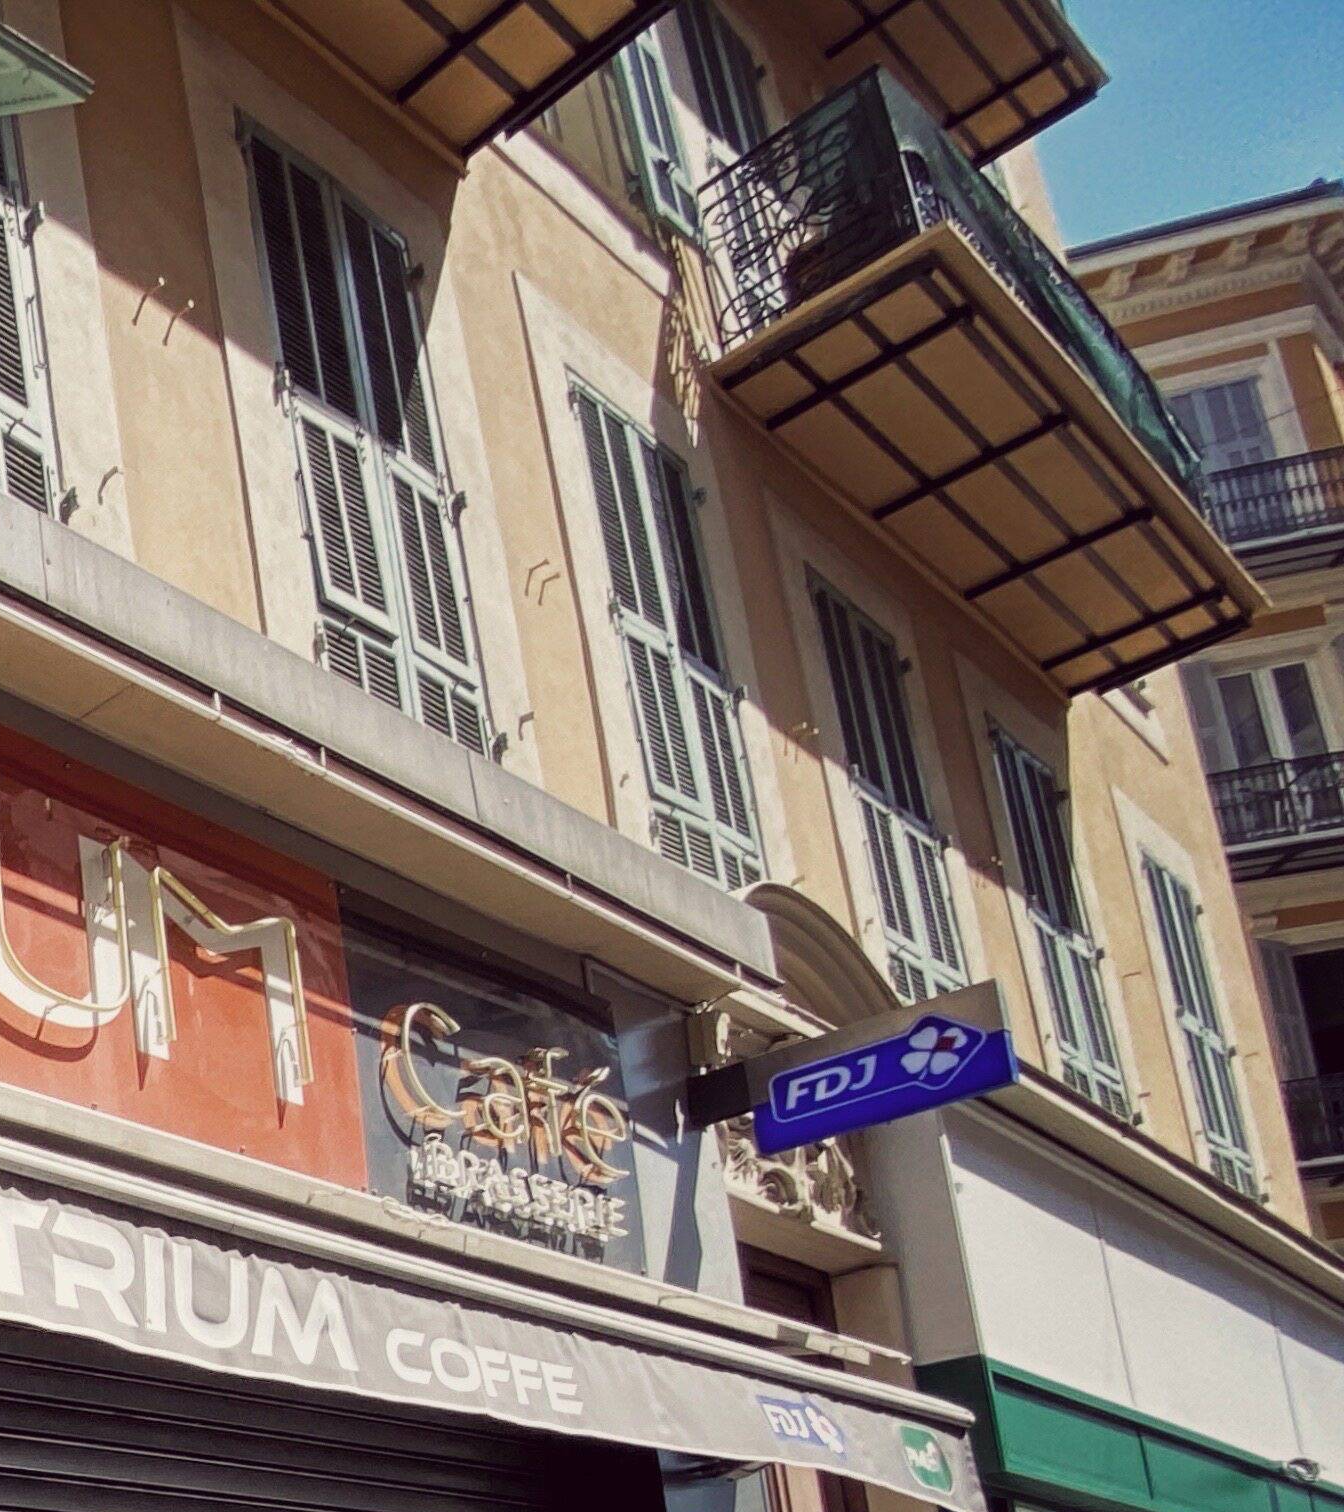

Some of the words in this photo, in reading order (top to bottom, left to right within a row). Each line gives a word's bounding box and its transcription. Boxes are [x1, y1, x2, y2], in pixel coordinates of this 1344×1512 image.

[379, 1002, 630, 1184] Café
[786, 1054, 877, 1110] FDJ
[408, 1134, 630, 1242] BRASSERIE
[386, 1329, 583, 1416] COFFE
[762, 1403, 809, 1439] FDJ
